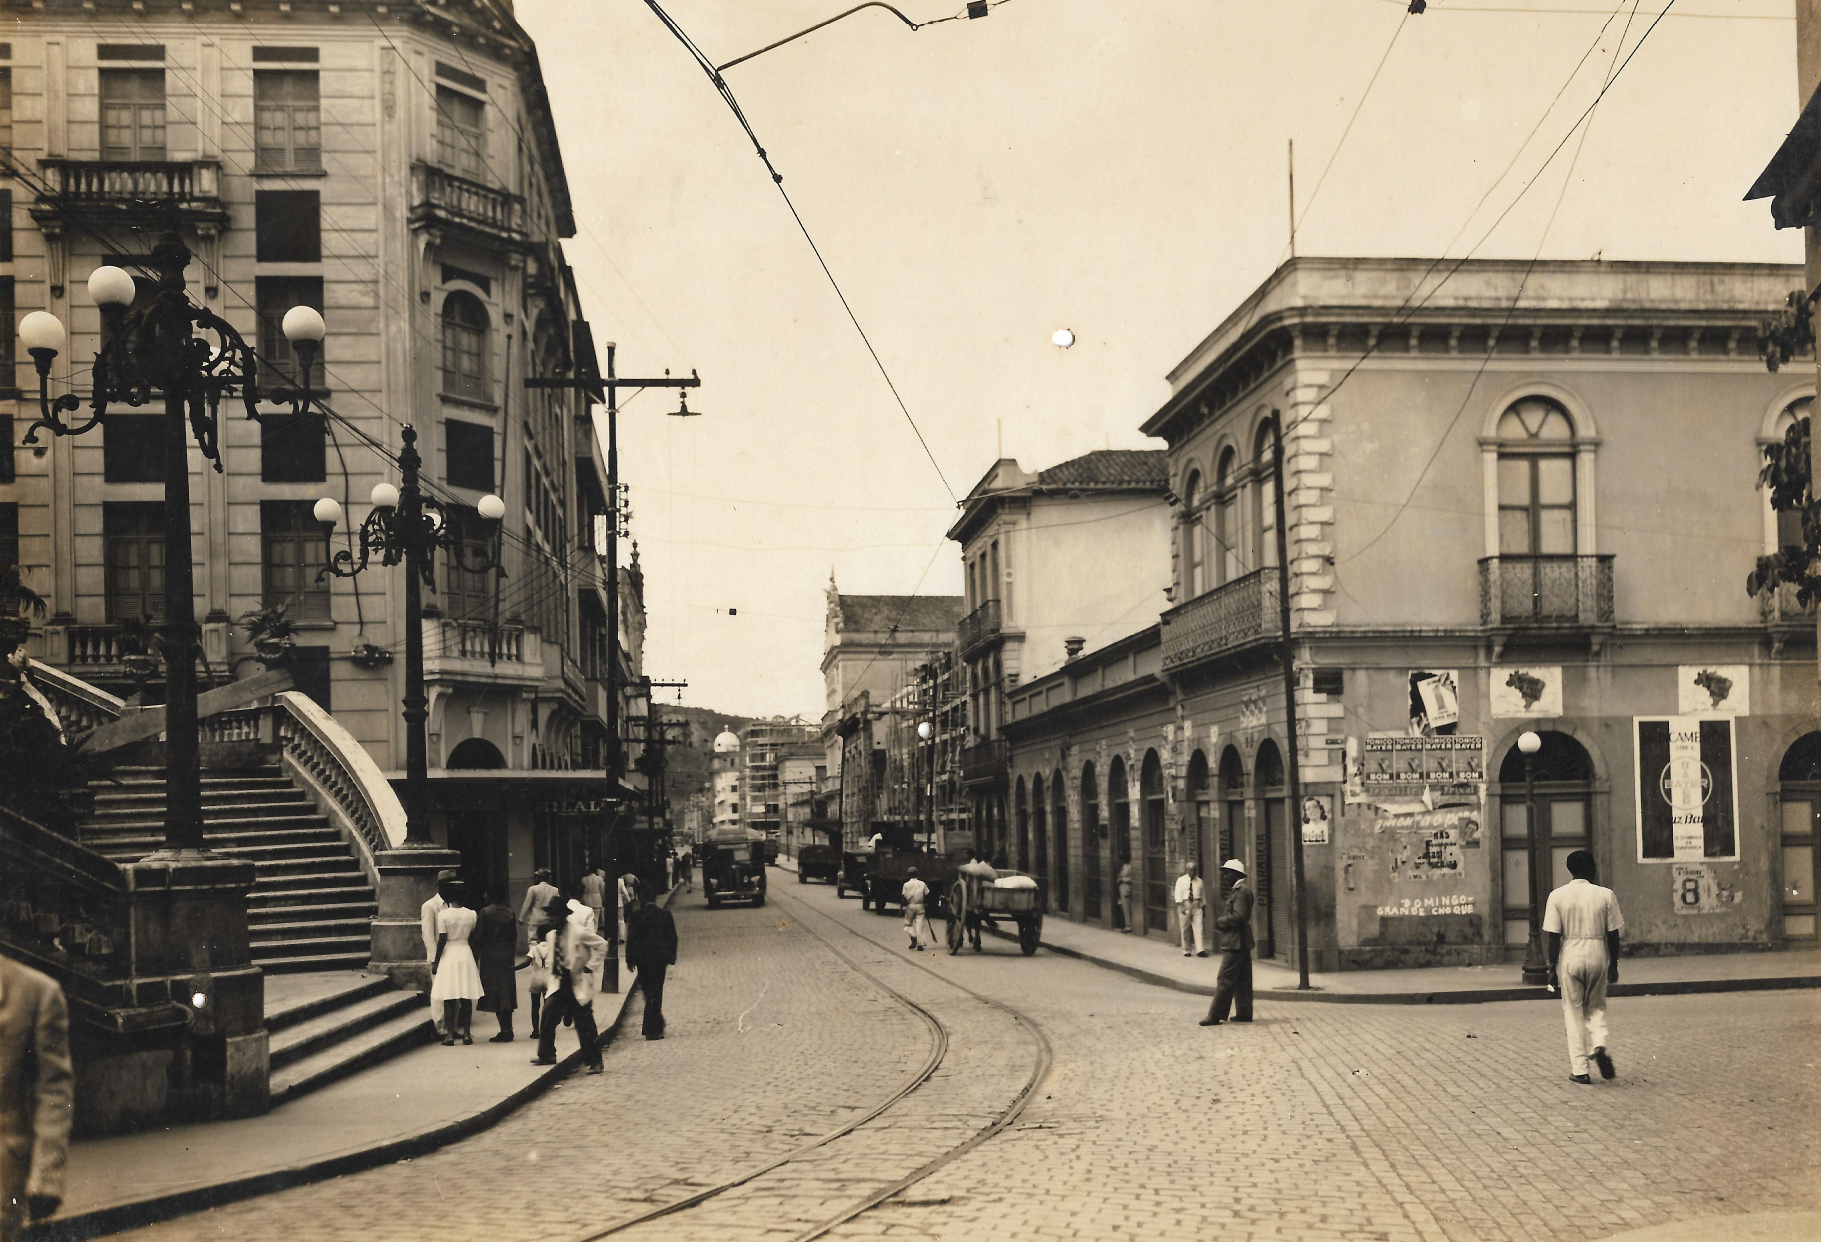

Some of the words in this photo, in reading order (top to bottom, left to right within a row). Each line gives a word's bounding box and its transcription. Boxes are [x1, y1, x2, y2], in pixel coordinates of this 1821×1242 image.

[1664, 779, 1708, 789] BAYER
[1681, 878, 1700, 905] 8
[1377, 906, 1425, 916] GRANDE
[1432, 904, 1474, 915] CHOQUE
